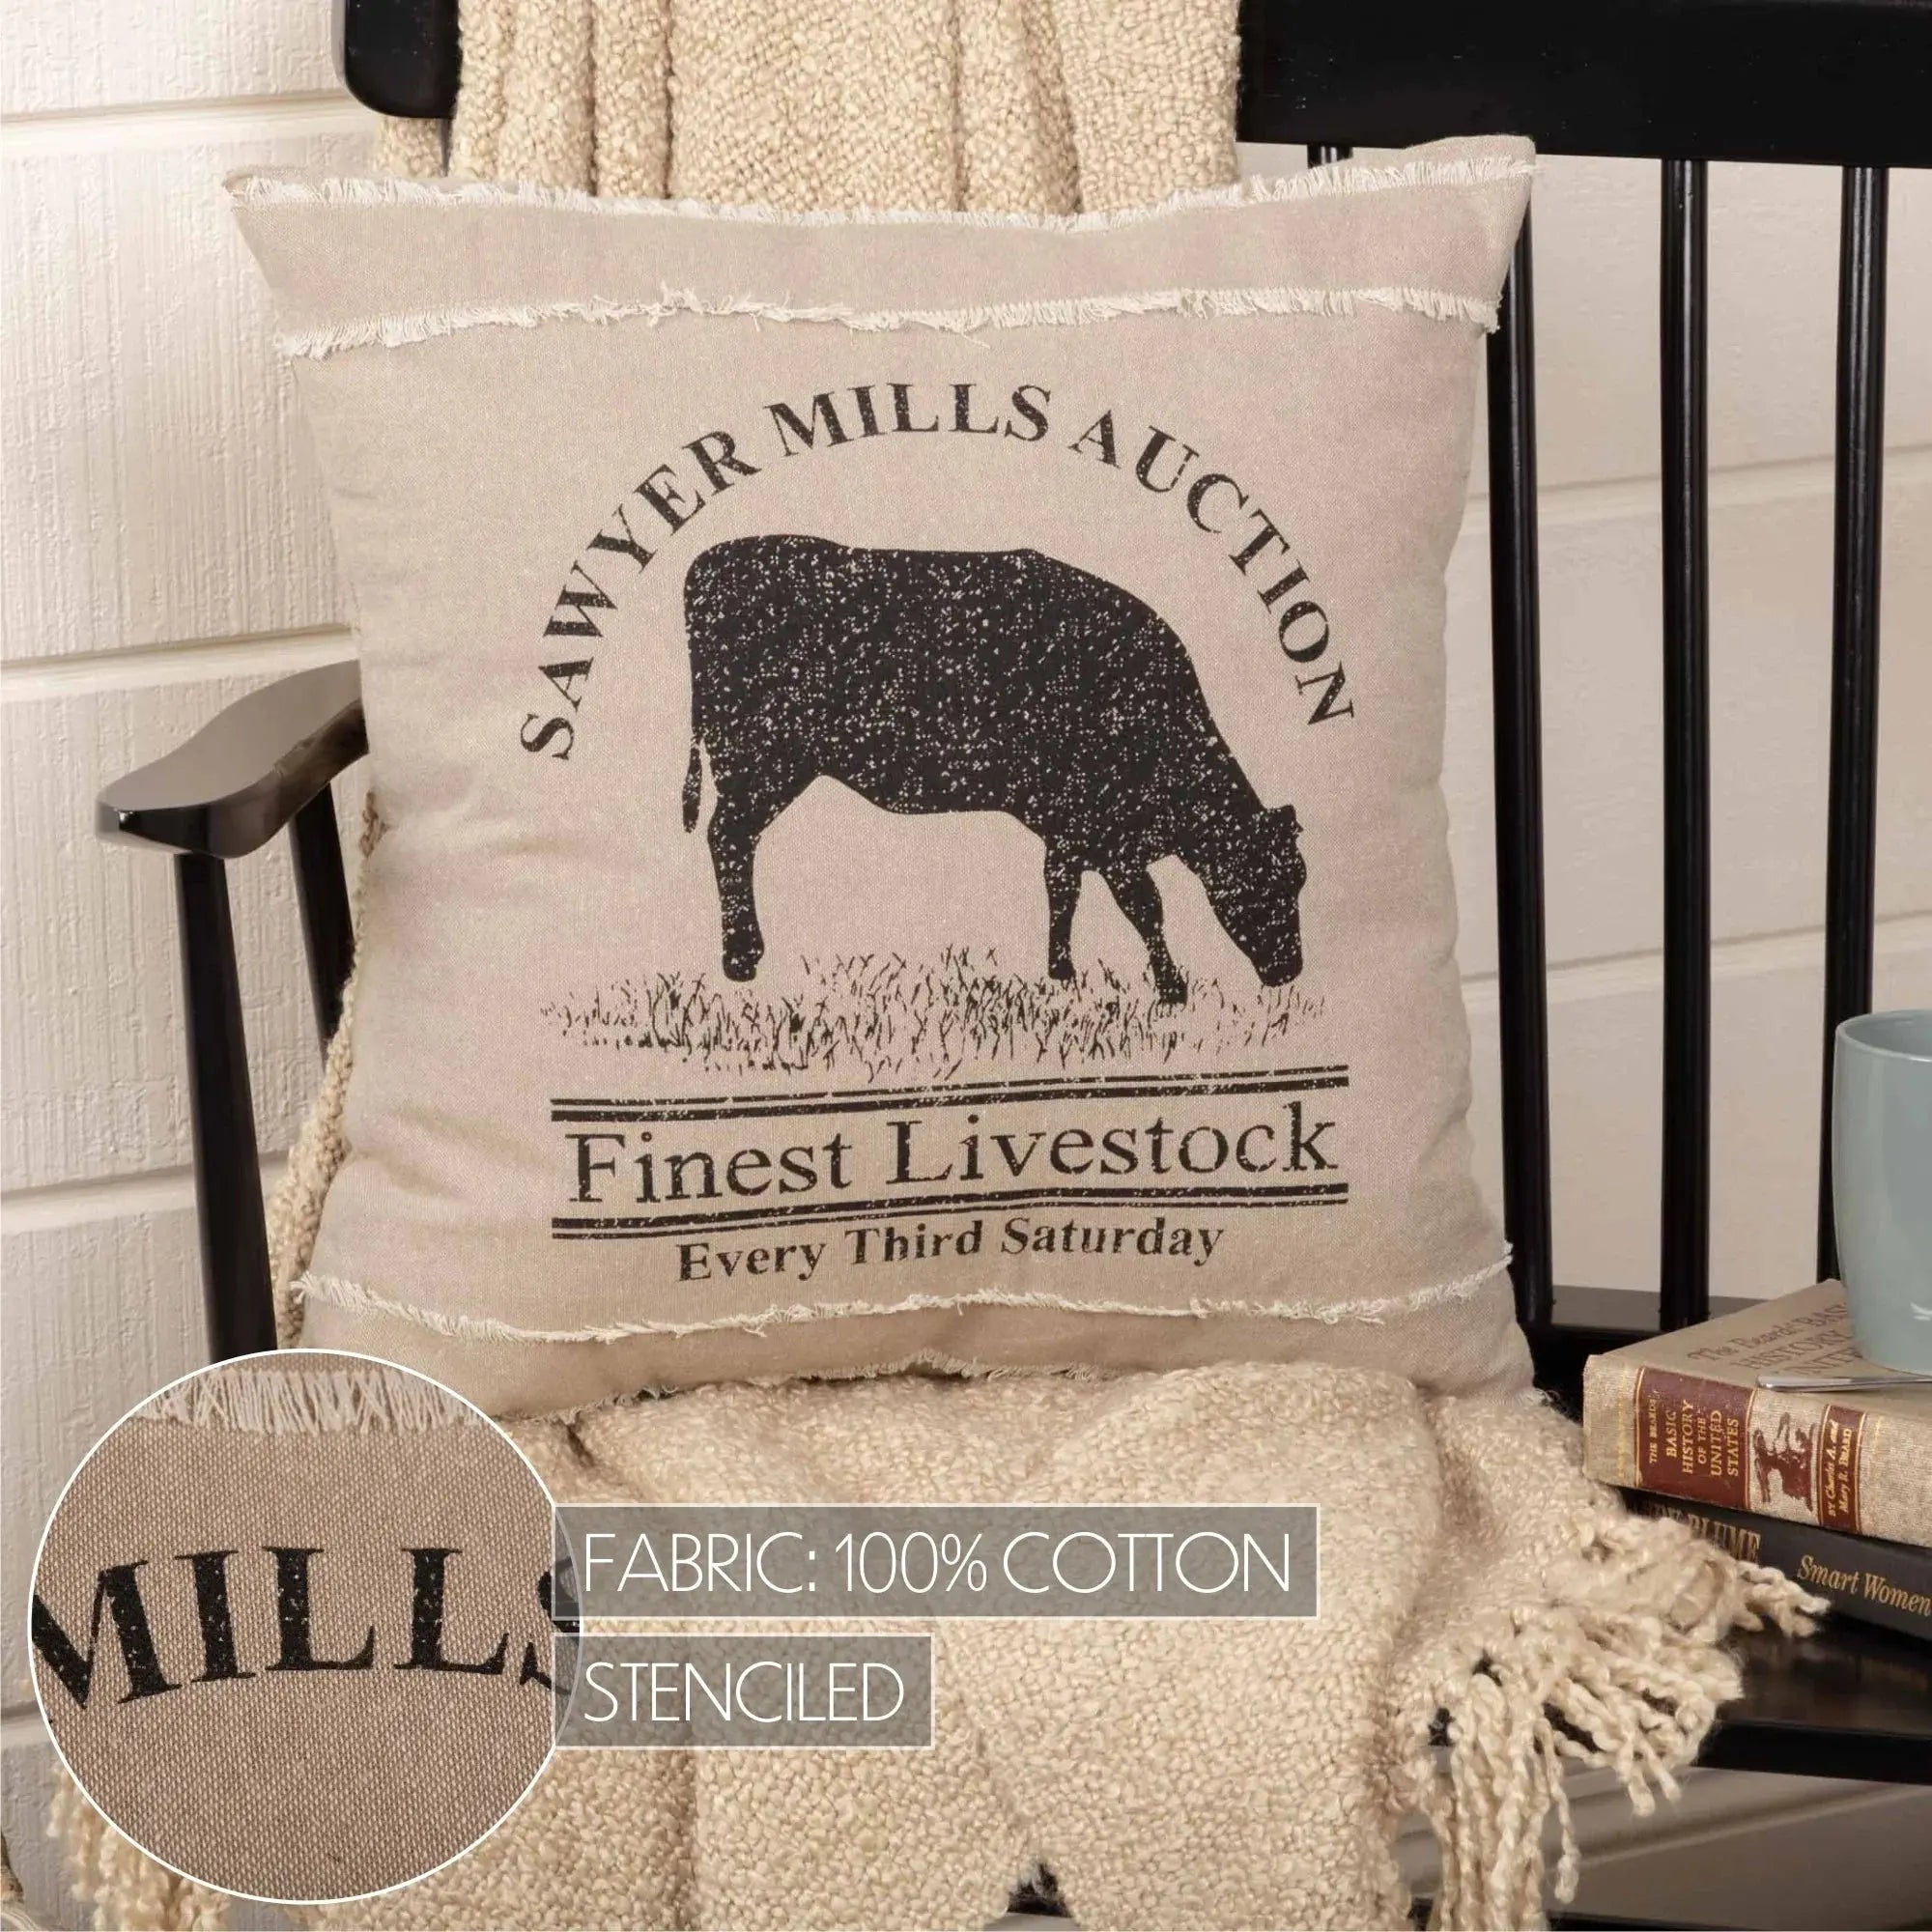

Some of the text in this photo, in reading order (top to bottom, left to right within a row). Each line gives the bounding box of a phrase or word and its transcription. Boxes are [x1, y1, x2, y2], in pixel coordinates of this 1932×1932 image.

[521, 383, 1353, 760] SAWYER MILLS AUCTION
[565, 1101, 1338, 1204] Finest Livestock
[676, 1216, 1224, 1282] Every Third Saturday
[1649, 1442, 1659, 1464] THE
[1665, 1409, 1678, 1459] BASIC
[1682, 1399, 1694, 1475] HISTORY
[1697, 1416, 1708, 1464] OF THE
[1710, 1409, 1722, 1477] UNITED
[1726, 1417, 1739, 1477] STATES
[1797, 1554, 1932, 1617] Smart Women
